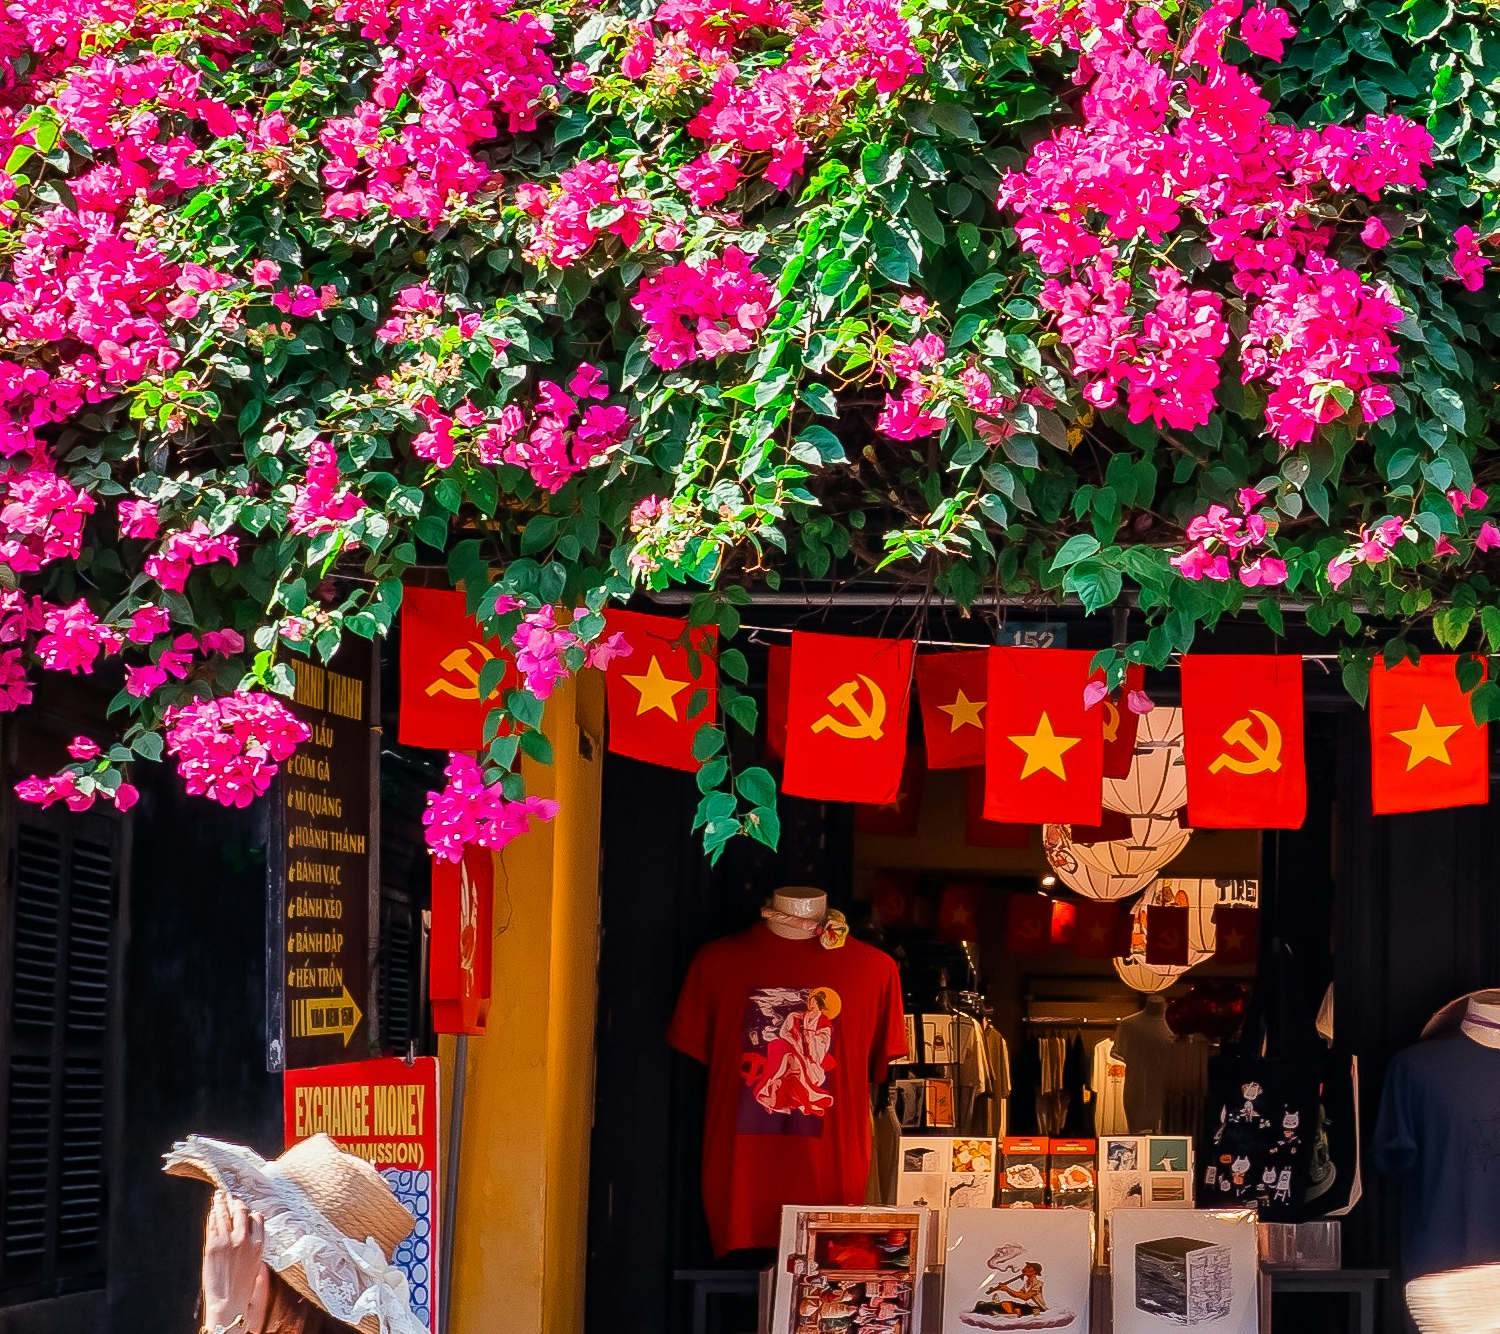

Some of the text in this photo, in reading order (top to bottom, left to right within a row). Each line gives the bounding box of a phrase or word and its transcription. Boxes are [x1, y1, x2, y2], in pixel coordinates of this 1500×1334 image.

[1013, 630, 1054, 648] 152
[328, 670, 362, 720] THANH
[330, 827, 365, 854] THÁNH
[296, 856, 322, 883] BÁNH
[296, 891, 322, 918] BÁNH
[296, 926, 322, 953] BÁNH
[295, 1085, 425, 1137] EXCHANGE MONEY
[341, 1142, 425, 1170] MMISSION)
